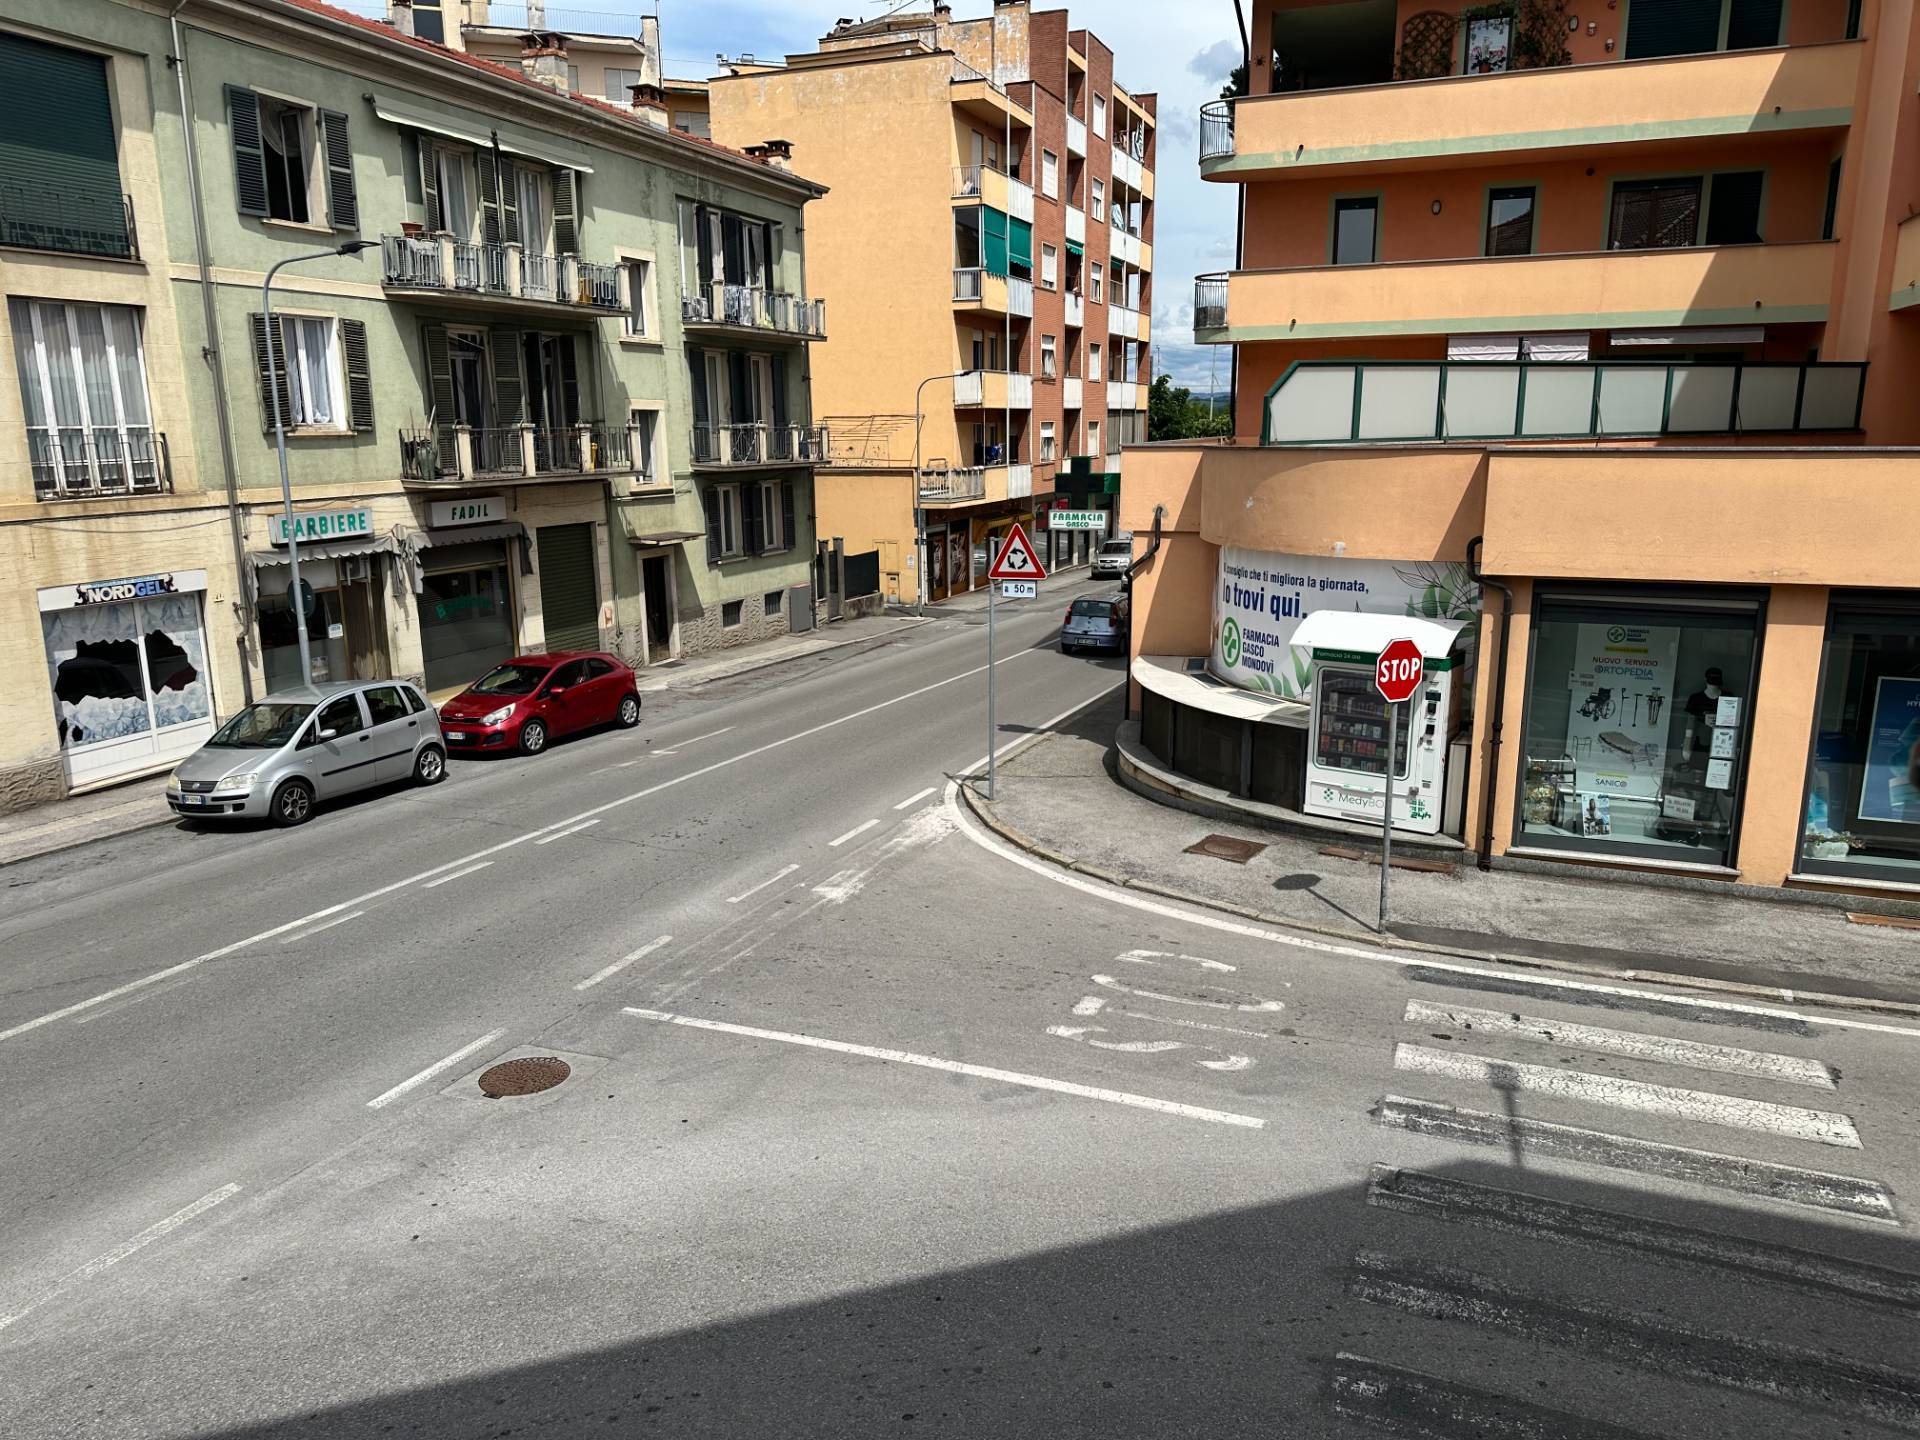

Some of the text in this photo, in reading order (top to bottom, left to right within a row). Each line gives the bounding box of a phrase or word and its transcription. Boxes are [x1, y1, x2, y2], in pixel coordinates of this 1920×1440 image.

[451, 503, 489, 521] FADIL
[1052, 512, 1104, 522] FARMACIA
[281, 511, 367, 539] BARBIERE
[1004, 585, 1009, 593] a
[1014, 584, 1025, 593] 50
[1249, 569, 1261, 581] che
[1263, 570, 1269, 582] ti
[1270, 573, 1305, 587] migliora
[1307, 576, 1316, 588] la
[1319, 577, 1369, 594] giornata,
[87, 580, 167, 603] NORDGEL
[1222, 578, 1231, 604] lo
[1233, 582, 1265, 612] trovi
[1242, 628, 1280, 648] FARMACIA
[1242, 642, 1265, 658] GASCO
[1241, 655, 1274, 674] MONDOVÌ
[1379, 657, 1421, 683] STOP
[1592, 656, 1658, 667] NUOVO SERVIZIO
[1338, 791, 1385, 809] MedyBO
